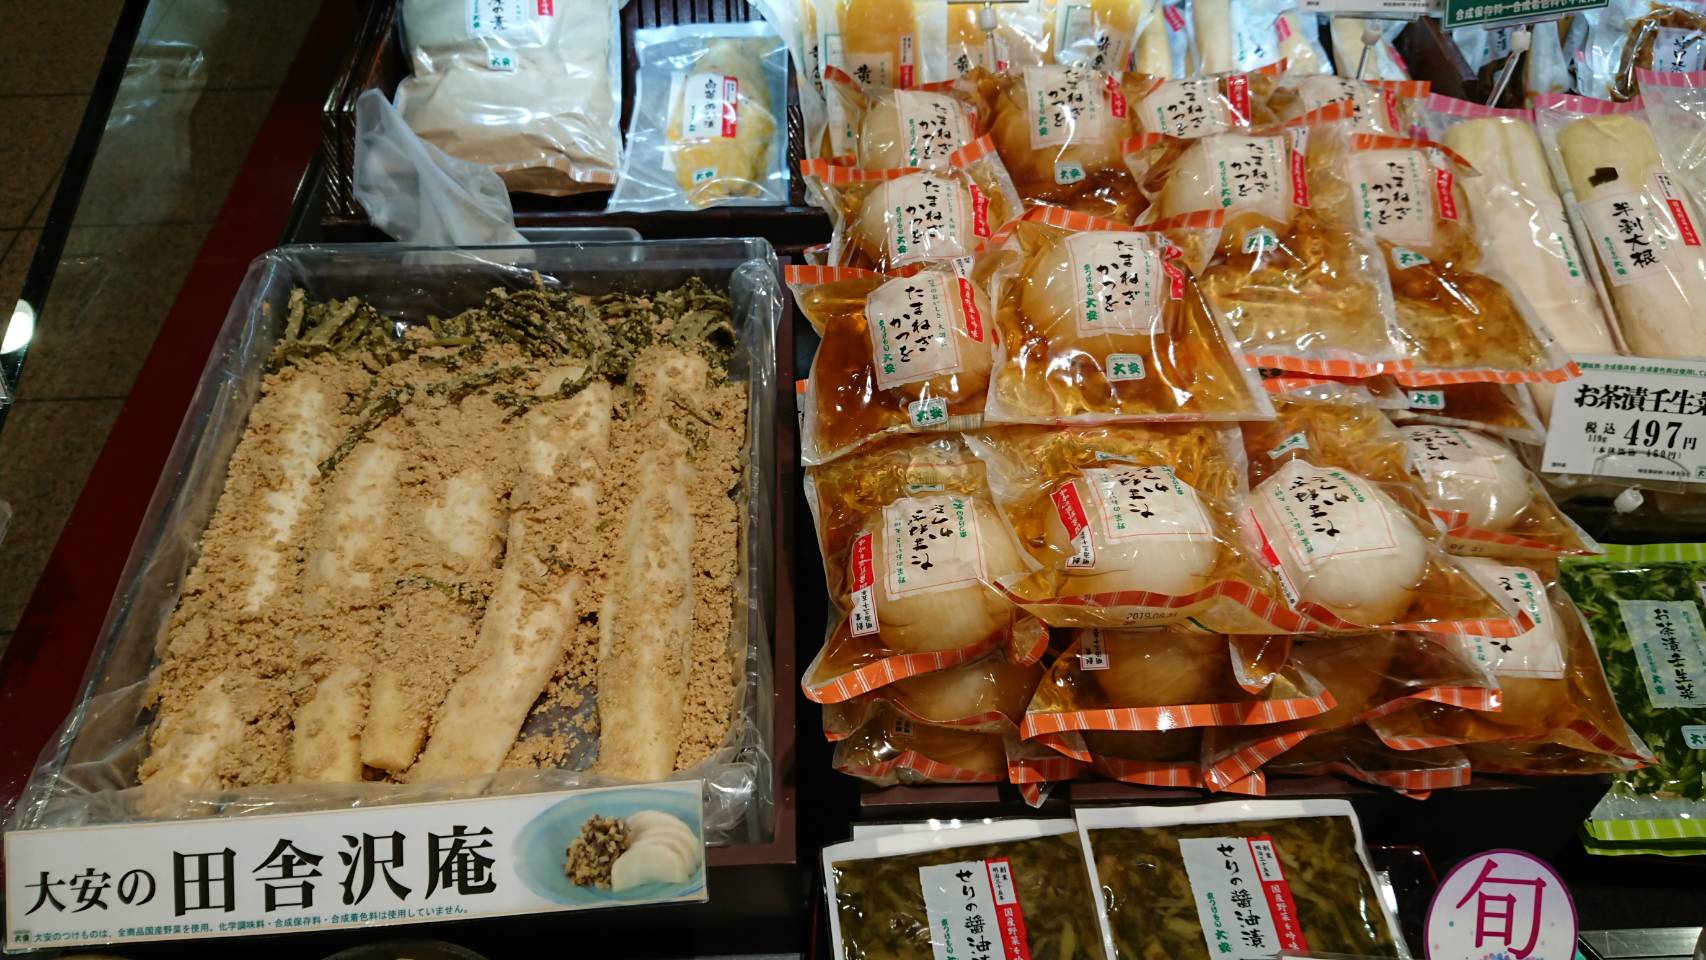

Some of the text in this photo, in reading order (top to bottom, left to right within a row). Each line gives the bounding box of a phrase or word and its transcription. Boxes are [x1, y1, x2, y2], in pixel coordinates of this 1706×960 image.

[919, 120, 936, 160] かつを
[932, 103, 952, 154] たまねぎ
[1230, 161, 1252, 196] かつを
[1246, 143, 1270, 192] たまねぎ
[1387, 162, 1412, 220] たまねぎ
[906, 204, 926, 244] かつを
[923, 180, 944, 238] たまねぎ
[1372, 183, 1392, 225] かつを
[1612, 202, 1660, 268] 半割大根
[1096, 263, 1119, 312] かつを
[1114, 240, 1140, 306] たまねぎ
[904, 286, 934, 352] たまねぎ
[1086, 298, 1099, 322] 大安
[889, 314, 914, 362] かつを
[883, 354, 896, 374] 大安
[1112, 362, 1142, 376] 大安
[929, 504, 954, 540] かつを
[1288, 476, 1341, 537] たまねぎ
[908, 510, 934, 570] たまねぎ
[1654, 608, 1697, 700] お茶漬壬生菜
[1690, 732, 1706, 745] 大
[173, 825, 497, 917] 田舎沢庵
[1456, 858, 1546, 960] 旬
[1216, 930, 1232, 954] 大安
